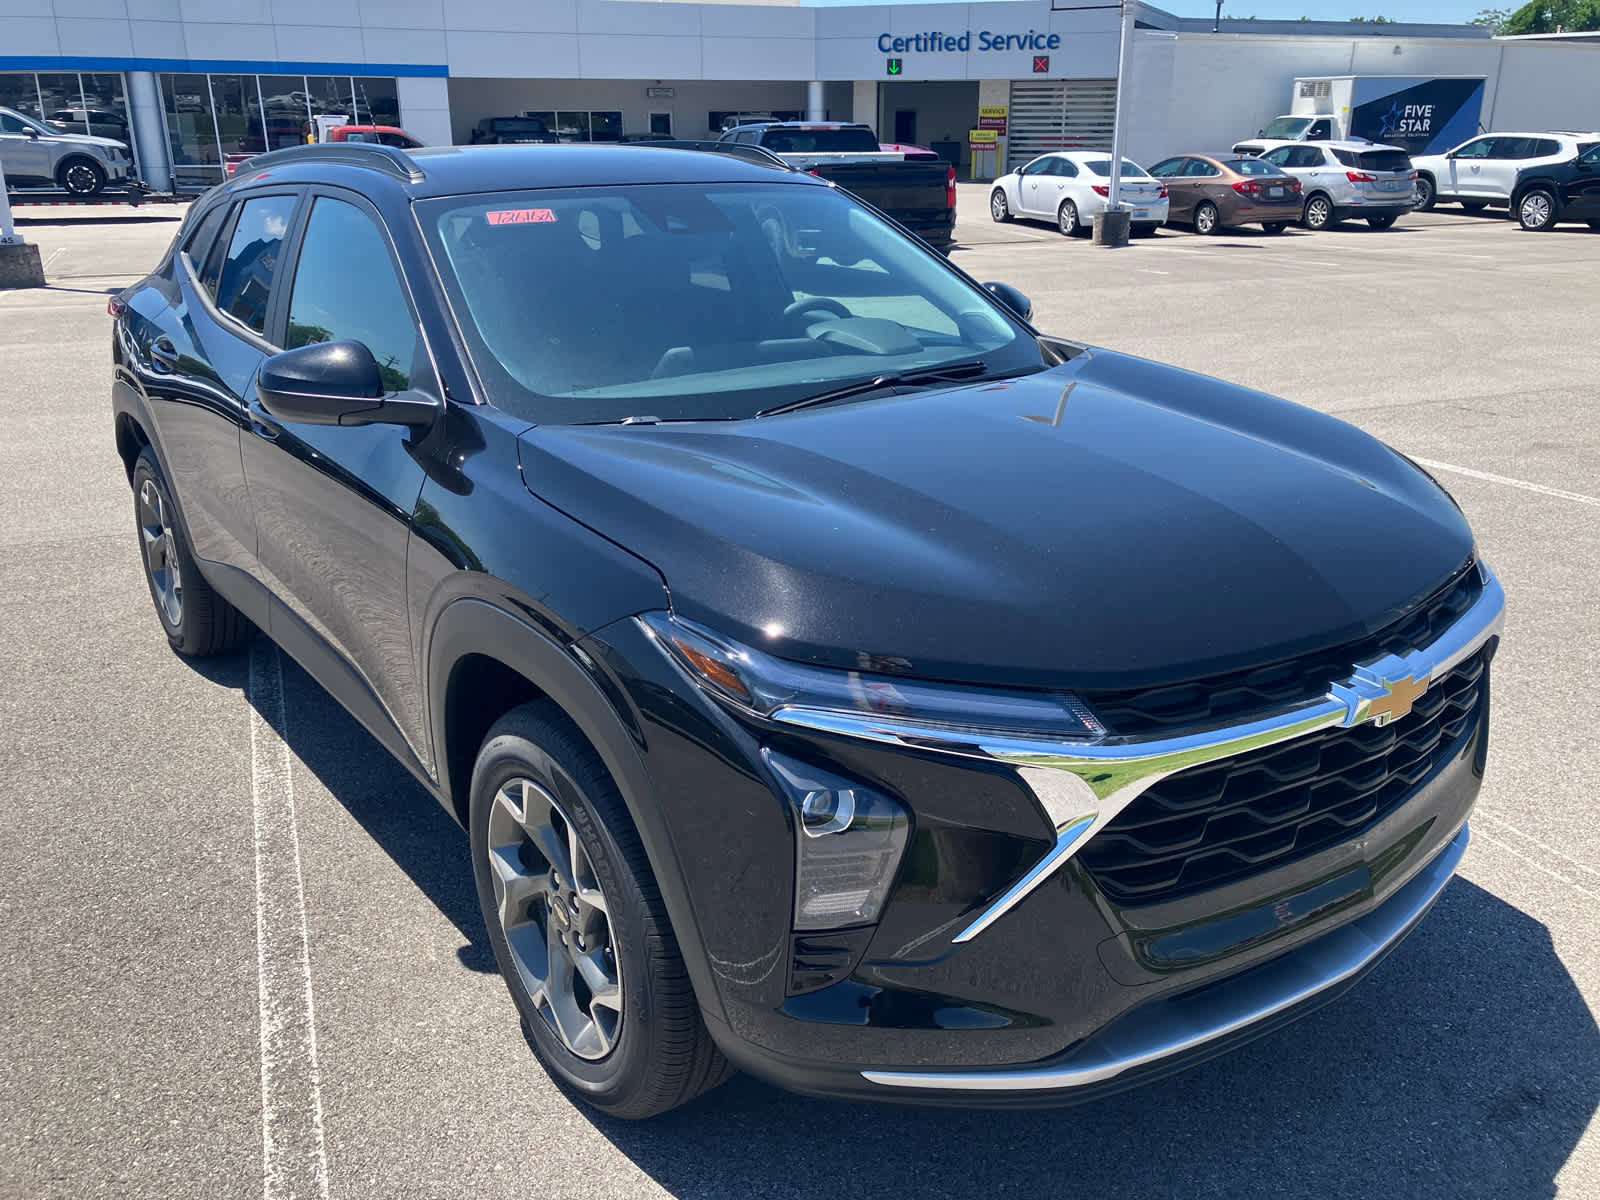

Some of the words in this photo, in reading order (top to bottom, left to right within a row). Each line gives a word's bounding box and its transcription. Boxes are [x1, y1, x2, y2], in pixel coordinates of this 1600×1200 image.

[877, 31, 970, 53] Certified
[978, 29, 1061, 51] Service
[1404, 104, 1433, 118] FIVE
[1399, 119, 1431, 132] STAR
